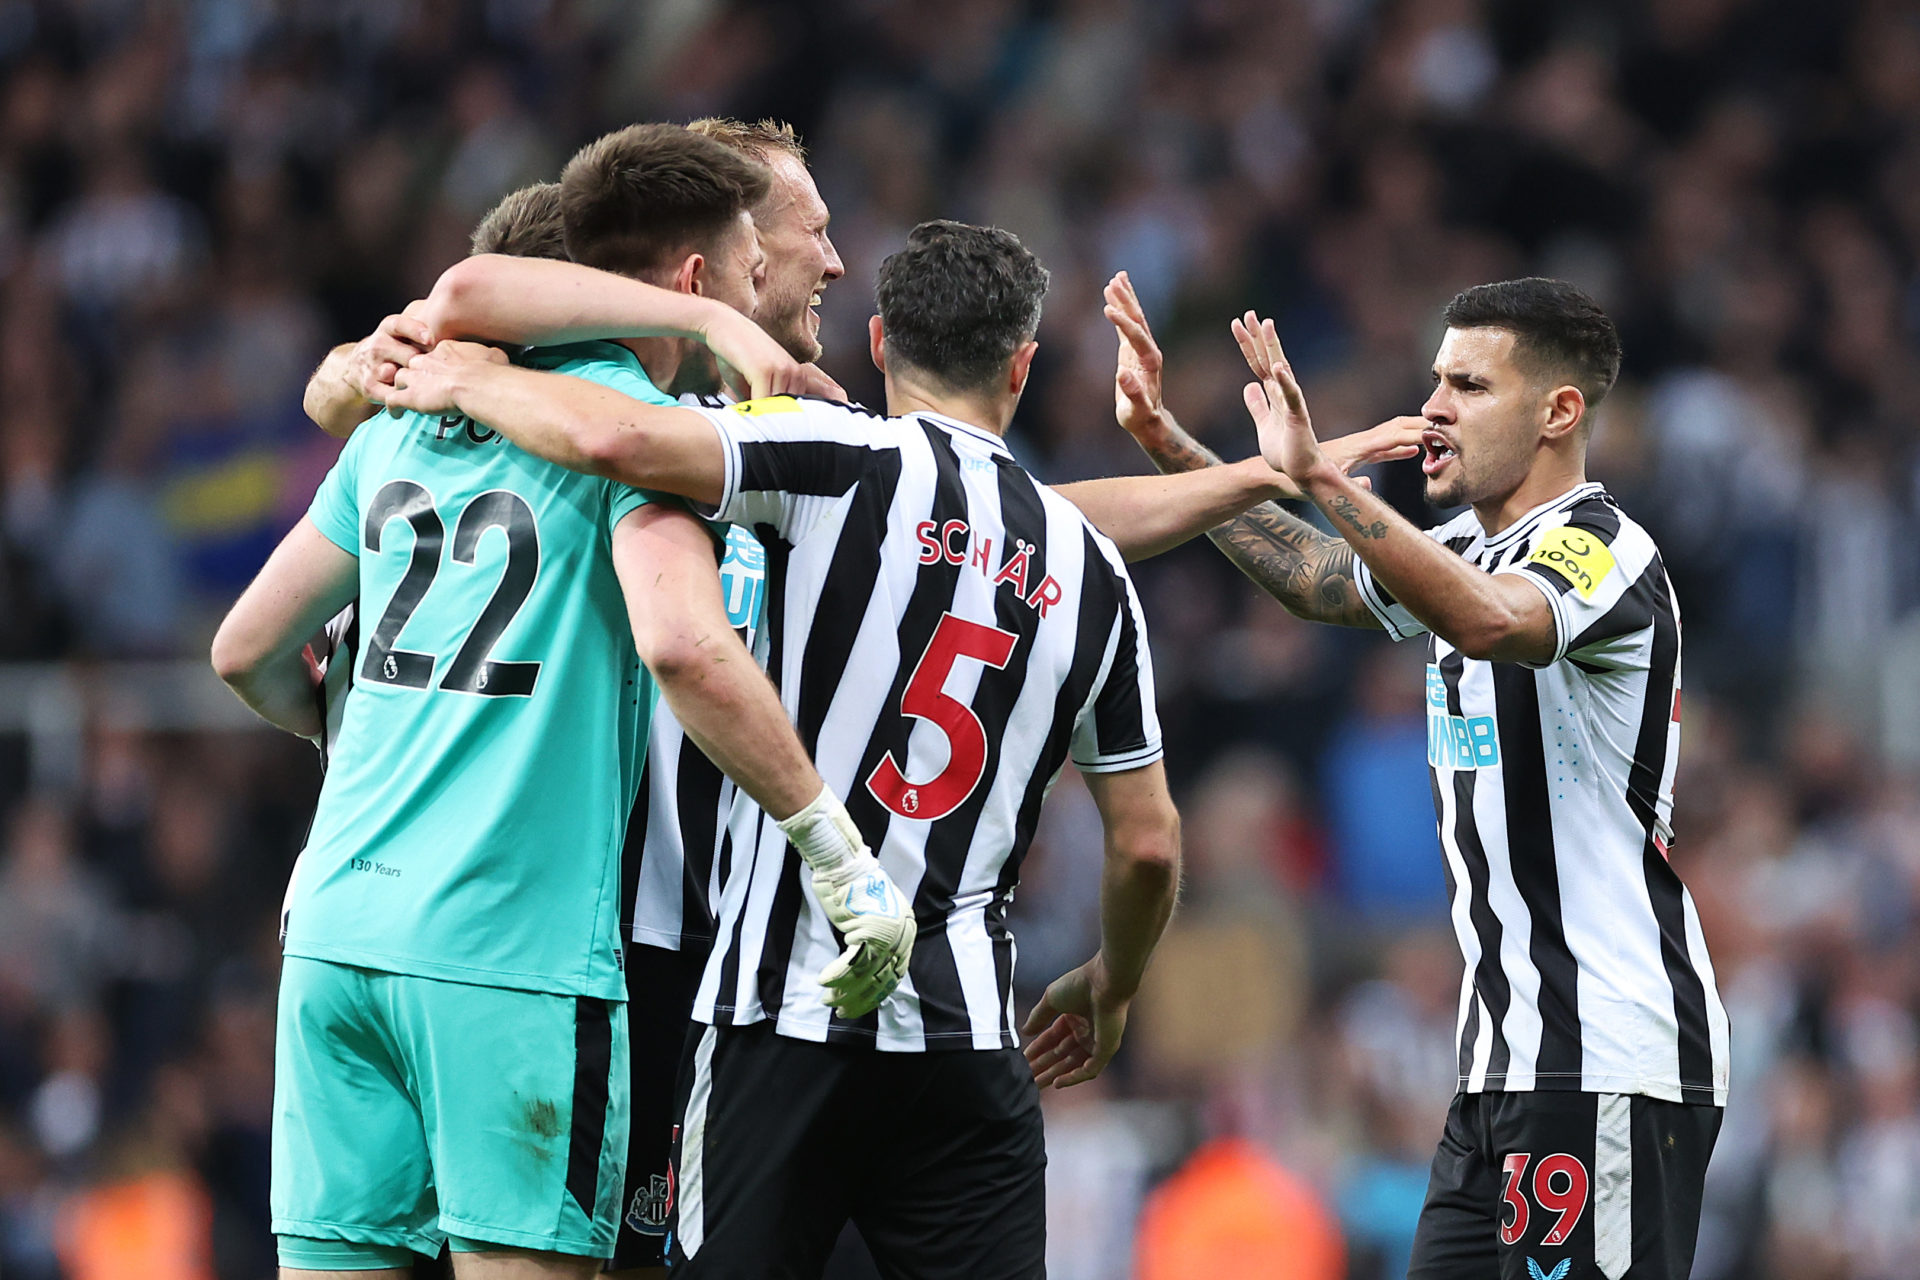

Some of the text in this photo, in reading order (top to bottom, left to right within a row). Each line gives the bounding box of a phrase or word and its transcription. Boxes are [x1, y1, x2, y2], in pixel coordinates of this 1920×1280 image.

[360, 478, 542, 697] 22
[915, 518, 1062, 619] SCHÄR
[1529, 550, 1593, 591] noon
[865, 611, 1019, 821] 5
[350, 857, 401, 878] 130 Years
[1500, 1153, 1589, 1246] 39
